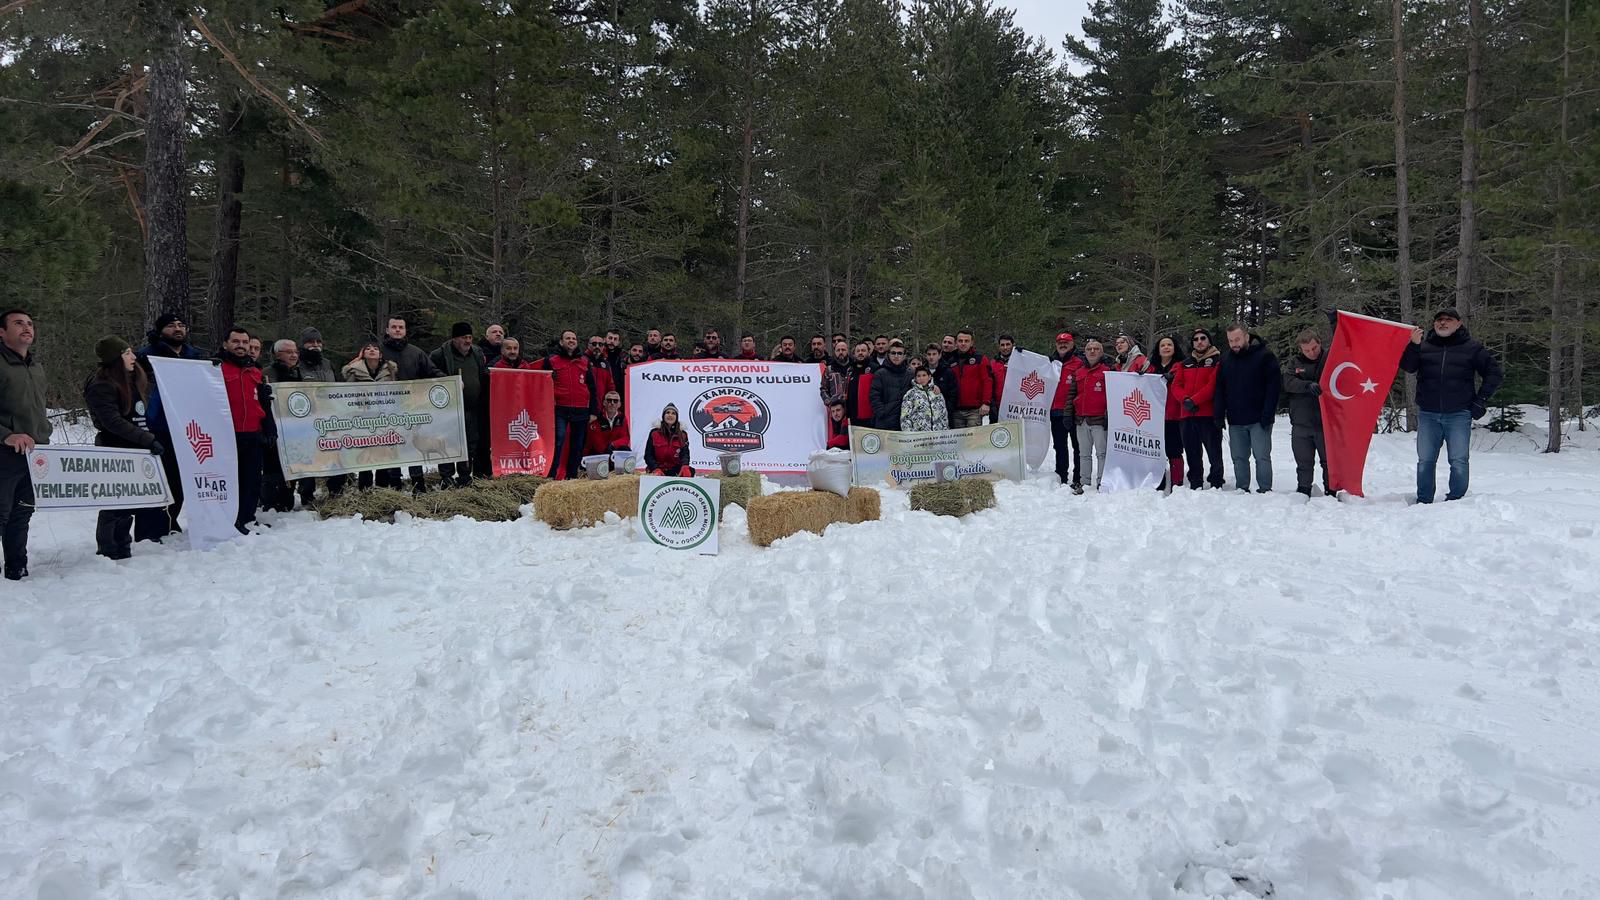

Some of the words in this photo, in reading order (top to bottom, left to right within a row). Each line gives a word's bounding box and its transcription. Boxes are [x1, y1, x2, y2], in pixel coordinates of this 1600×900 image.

[642, 372, 684, 383] KAMP
[689, 376, 751, 384] OFFROAD
[756, 374, 811, 384] KULÜBÜ
[703, 389, 755, 400] KAMPOFF
[315, 416, 352, 436] Yaban
[352, 412, 389, 433] Hayatı
[388, 412, 433, 430] Doğanın
[318, 438, 342, 451] Can
[342, 430, 405, 448] Damarıdır.
[1114, 432, 1160, 449] VAKIFLAR
[1114, 443, 1130, 451] GENEL
[60, 457, 99, 472] YABAN
[102, 459, 135, 472] HAYATI
[890, 453, 936, 469] Doğanın
[891, 469, 936, 484] Yaşamın
[34, 483, 89, 498] YEMLEME
[91, 482, 162, 499] ÇALIŞMALARI
[672, 487, 699, 498] PARKLAR
[698, 498, 708, 517] GENEL
